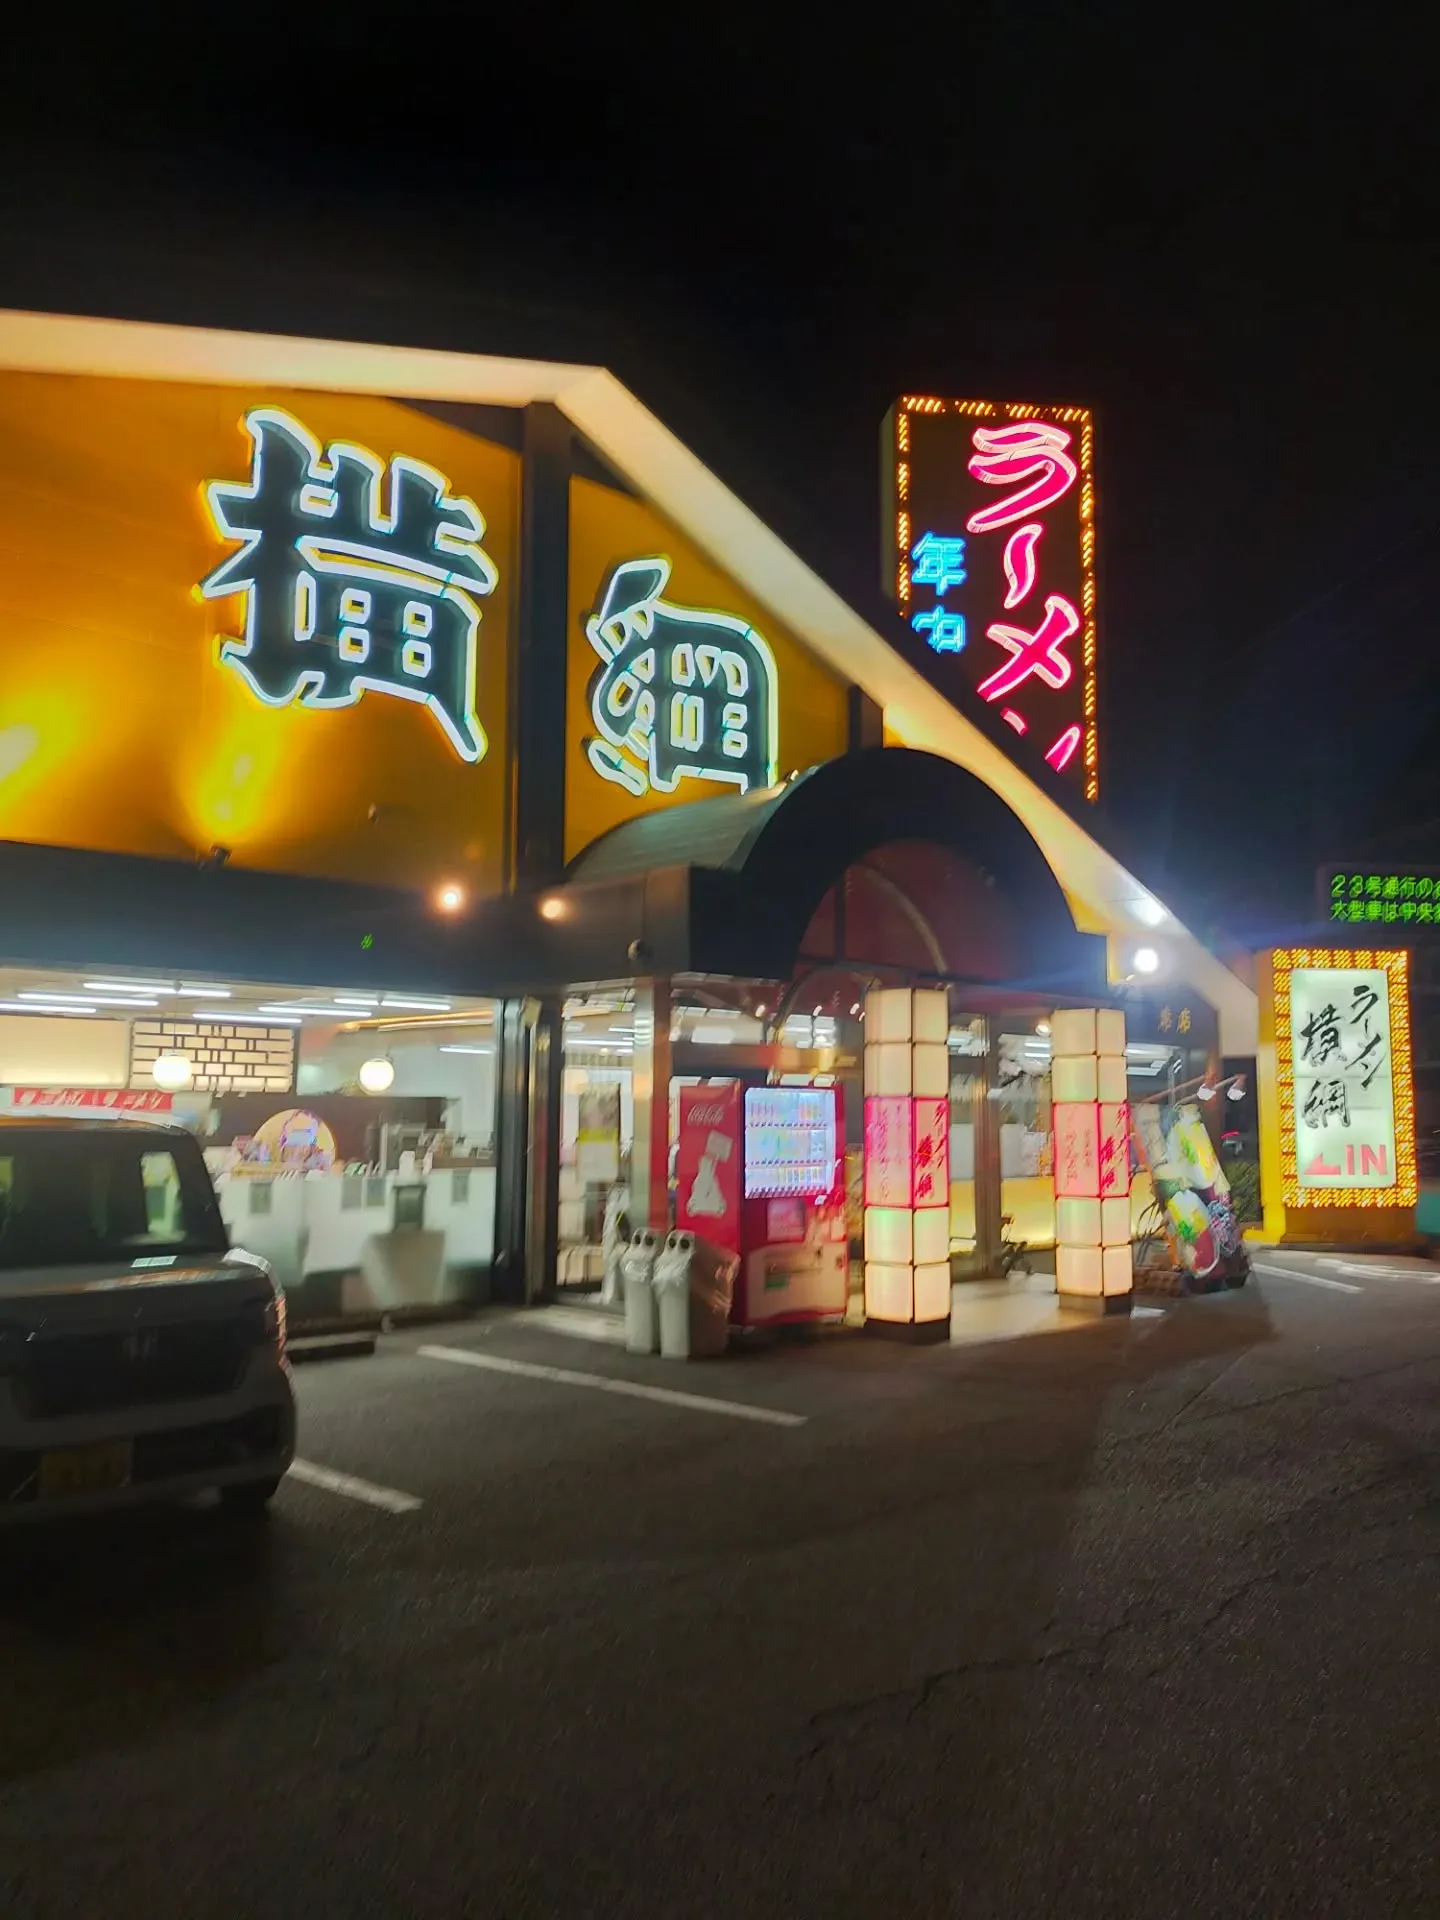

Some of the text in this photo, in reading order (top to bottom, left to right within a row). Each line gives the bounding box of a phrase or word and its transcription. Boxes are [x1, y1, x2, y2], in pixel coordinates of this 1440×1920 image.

[202, 405, 778, 797] 横綱
[1300, 1003, 1350, 1128] 横綱
[1345, 985, 1386, 1089] ラーメン
[1346, 1144, 1388, 1176] IN
